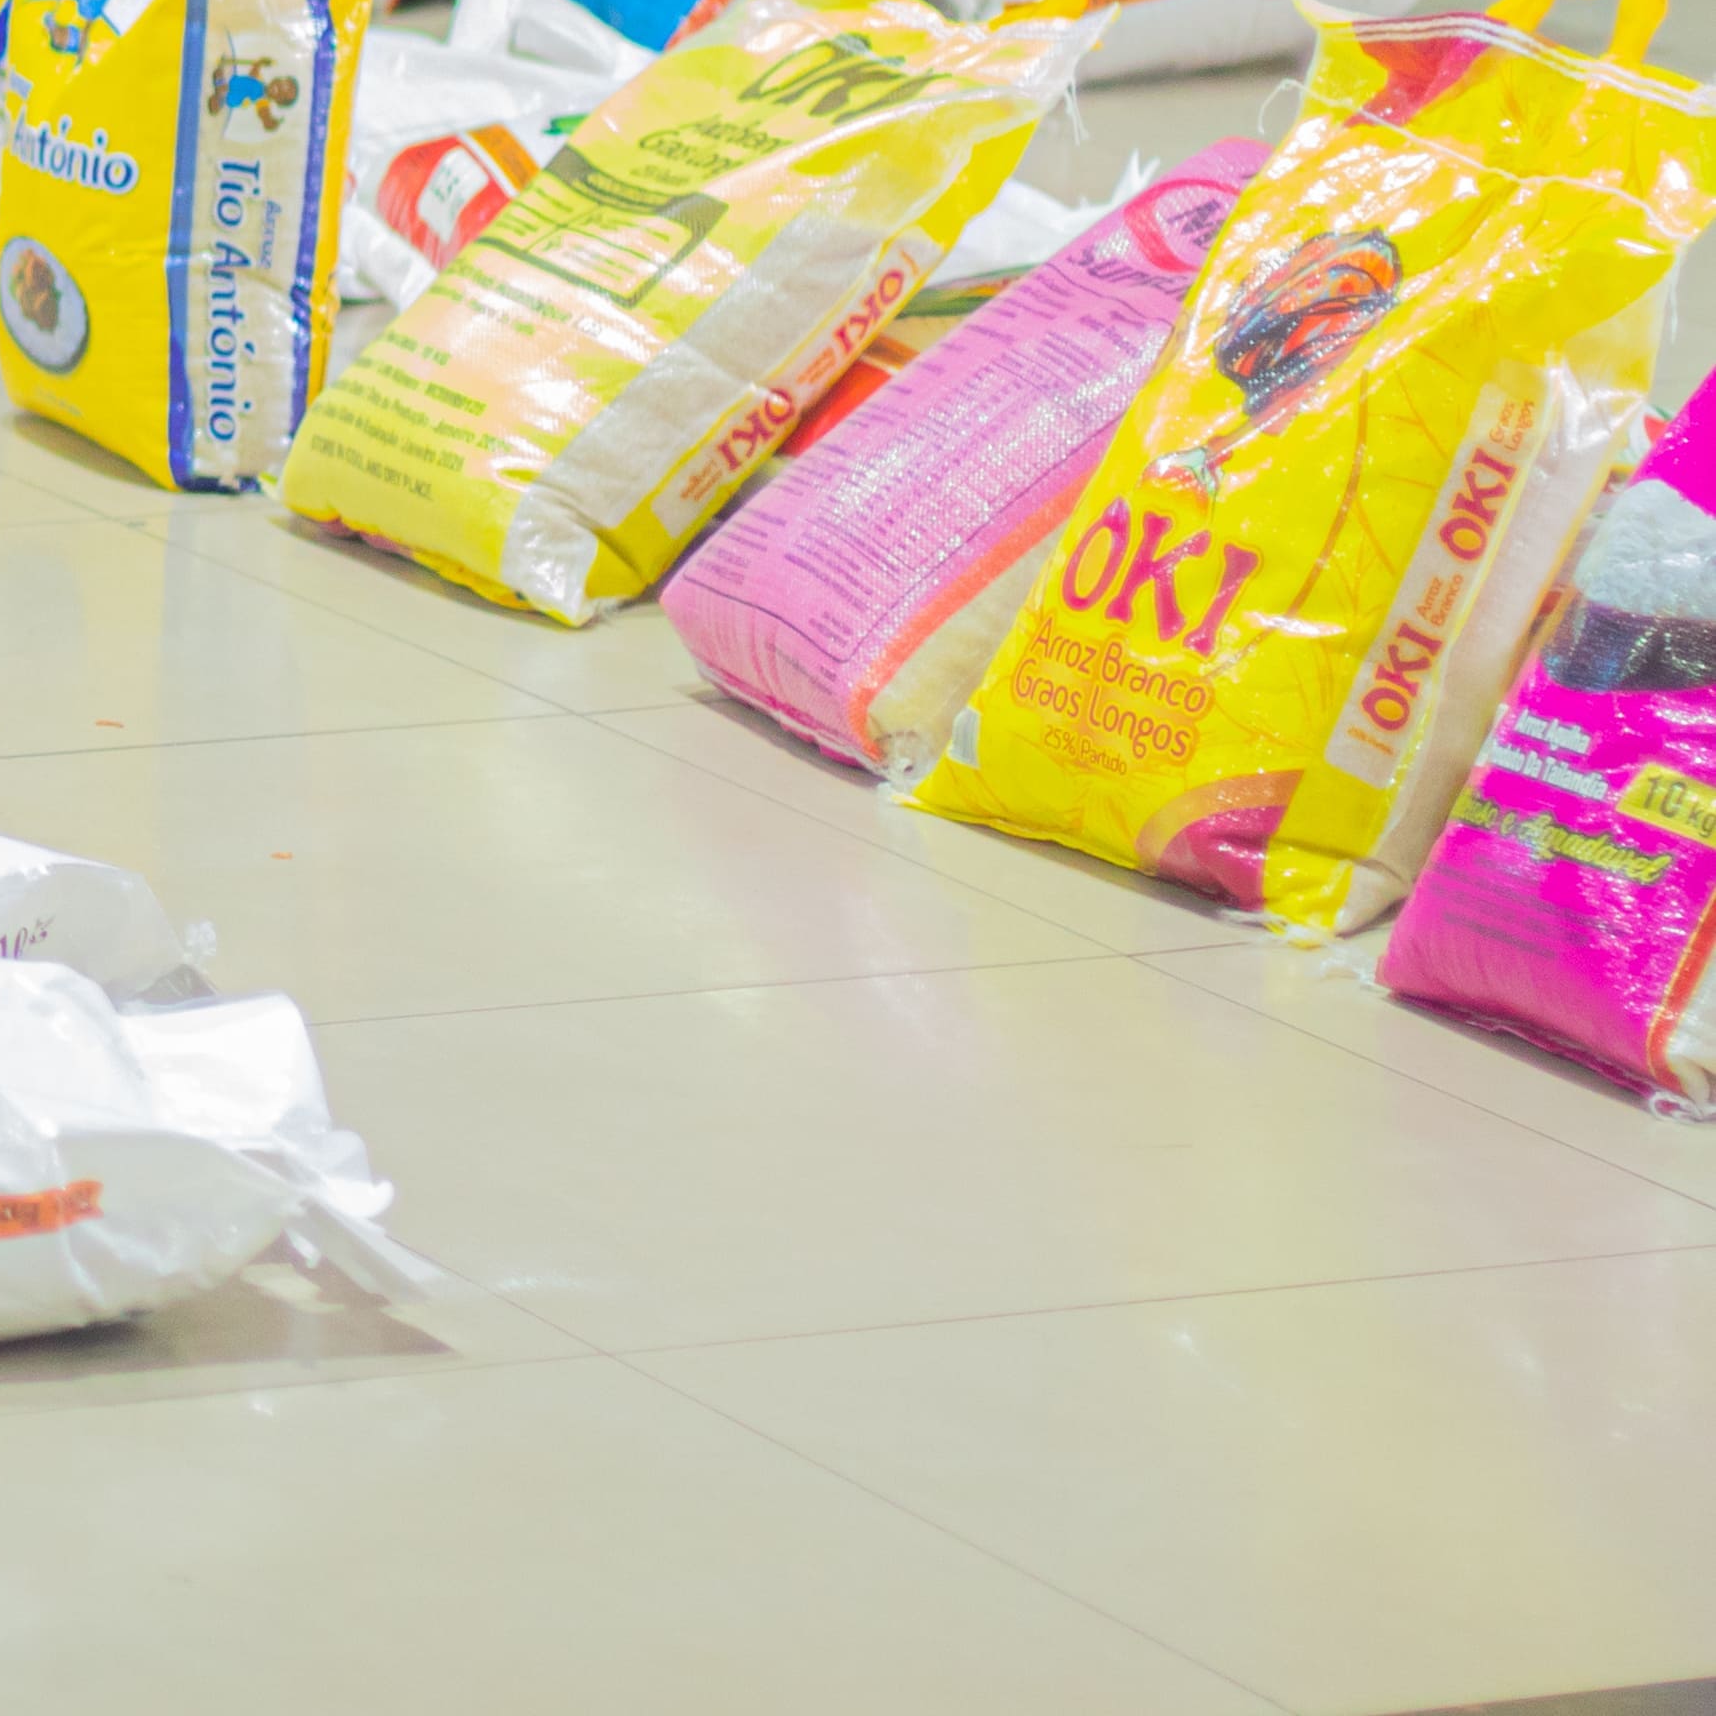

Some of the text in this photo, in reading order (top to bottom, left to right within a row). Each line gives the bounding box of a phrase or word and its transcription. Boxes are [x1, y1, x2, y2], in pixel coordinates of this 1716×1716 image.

[208, 157, 261, 444] Tio António
[833, 269, 905, 355] OKI
[718, 387, 796, 471] OKI
[1438, 447, 1519, 564] OKI
[1062, 495, 1260, 658] OKI
[1417, 576, 1444, 620] Arroz
[1431, 573, 1464, 629] Branco
[1014, 657, 1192, 760] Graos Longos
[1030, 616, 1208, 714] Arroz Branco
[1361, 621, 1445, 733] OKI
[1043, 724, 1129, 777] 25% Partido
[1643, 774, 1716, 839] 10 kg
